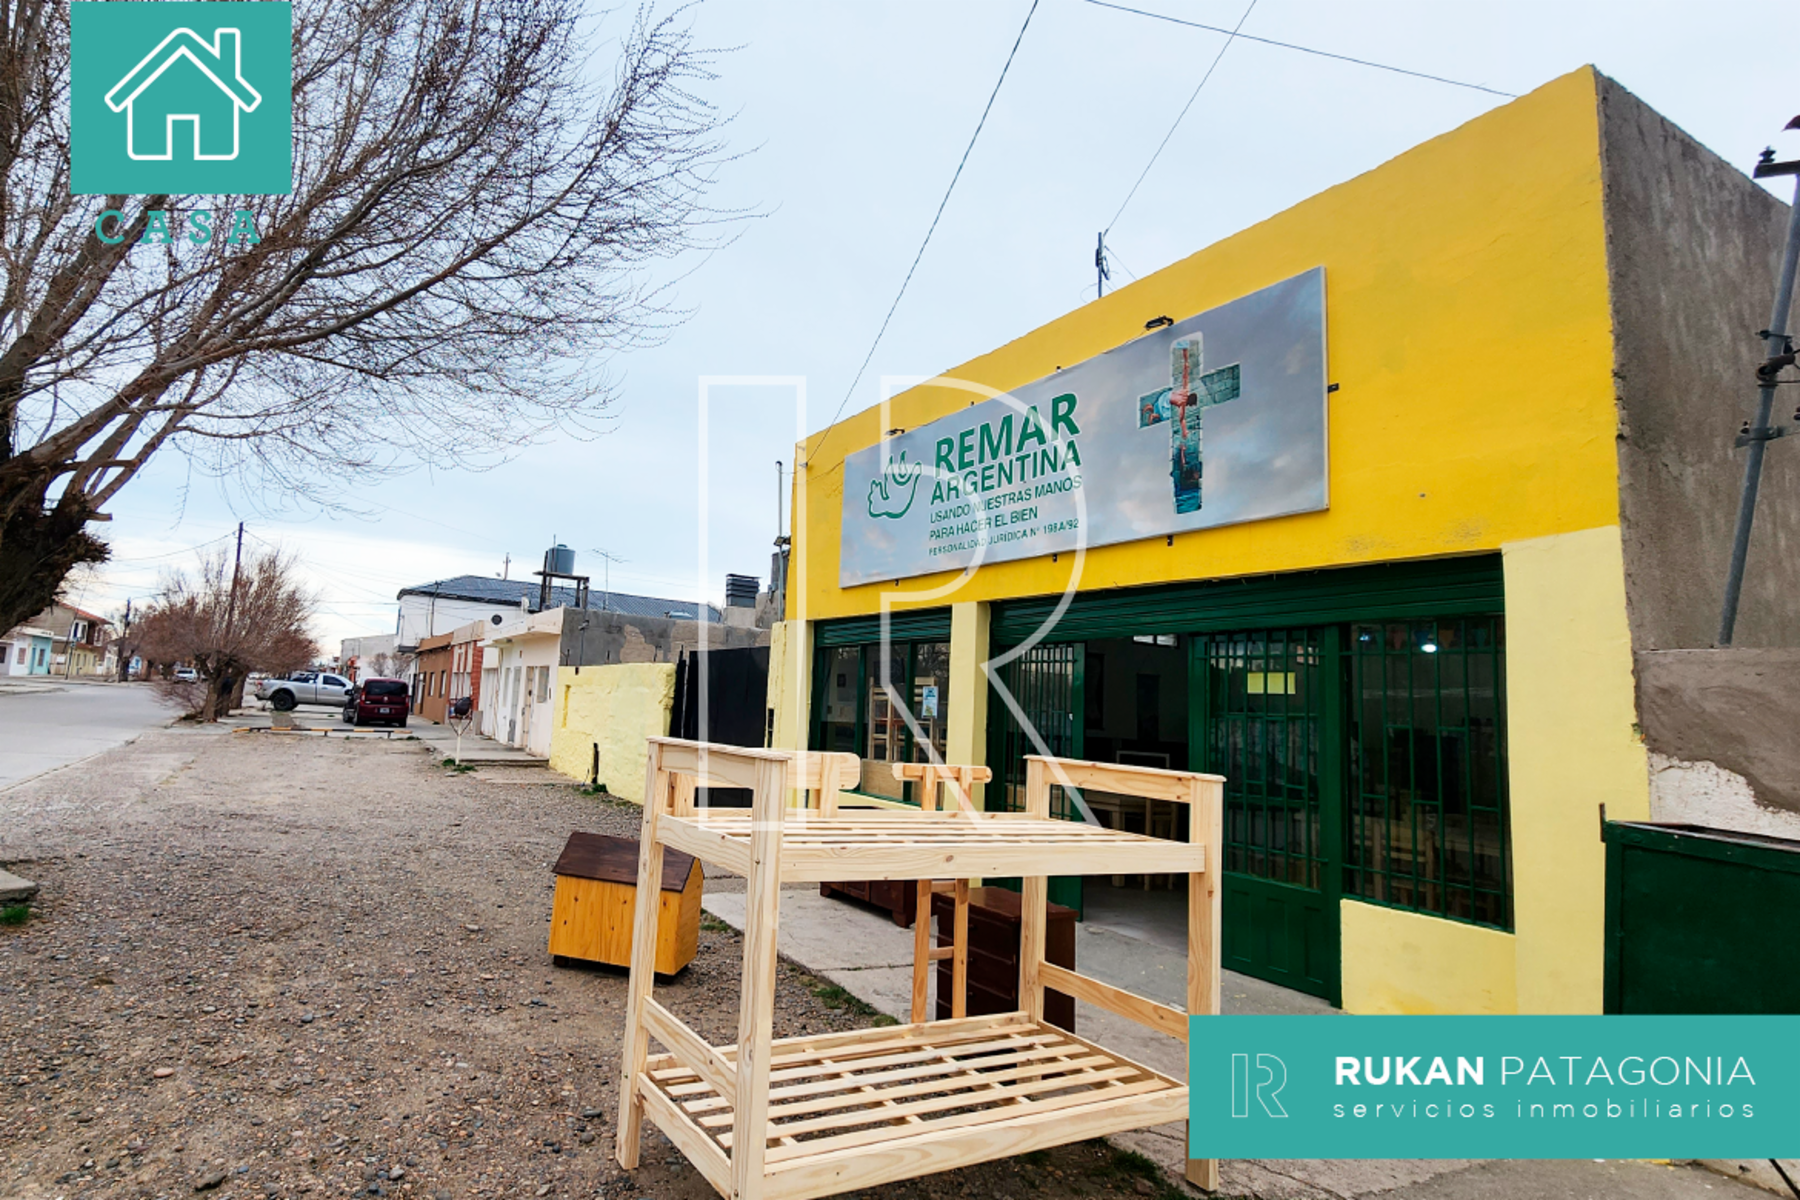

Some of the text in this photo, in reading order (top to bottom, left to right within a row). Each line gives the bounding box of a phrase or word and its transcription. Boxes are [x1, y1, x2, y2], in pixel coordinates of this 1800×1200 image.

[935, 393, 1080, 477] REMAR
[930, 440, 1081, 505] ARGENTINA
[930, 475, 1082, 524] USANDO NUESTRAS MANOS
[929, 506, 1038, 541] PARA HACER EL BIEN
